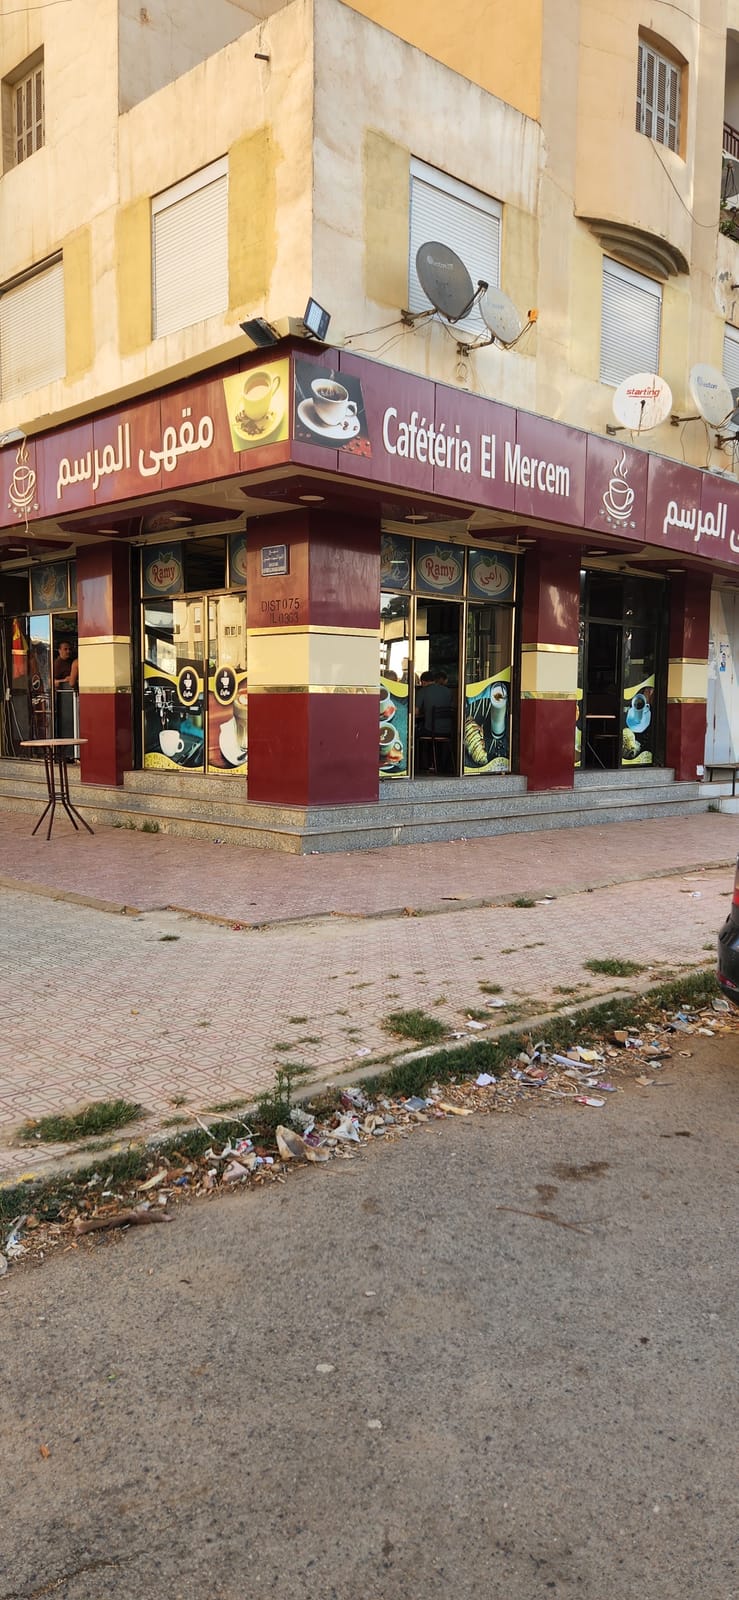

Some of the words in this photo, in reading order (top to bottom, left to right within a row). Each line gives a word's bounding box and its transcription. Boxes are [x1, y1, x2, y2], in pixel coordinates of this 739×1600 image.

[626, 387, 660, 398] starting
[138, 408, 214, 477] مقهى
[382, 408, 472, 474] Cafétéria
[480, 434, 496, 480] El
[504, 441, 570, 497] Mercem
[56, 423, 131, 499] المرسم
[663, 501, 728, 542] المرسم
[152, 565, 175, 584] Ramy
[425, 557, 455, 580] Ramy
[480, 566, 503, 587] رامي
[261, 599, 281, 613] DIST
